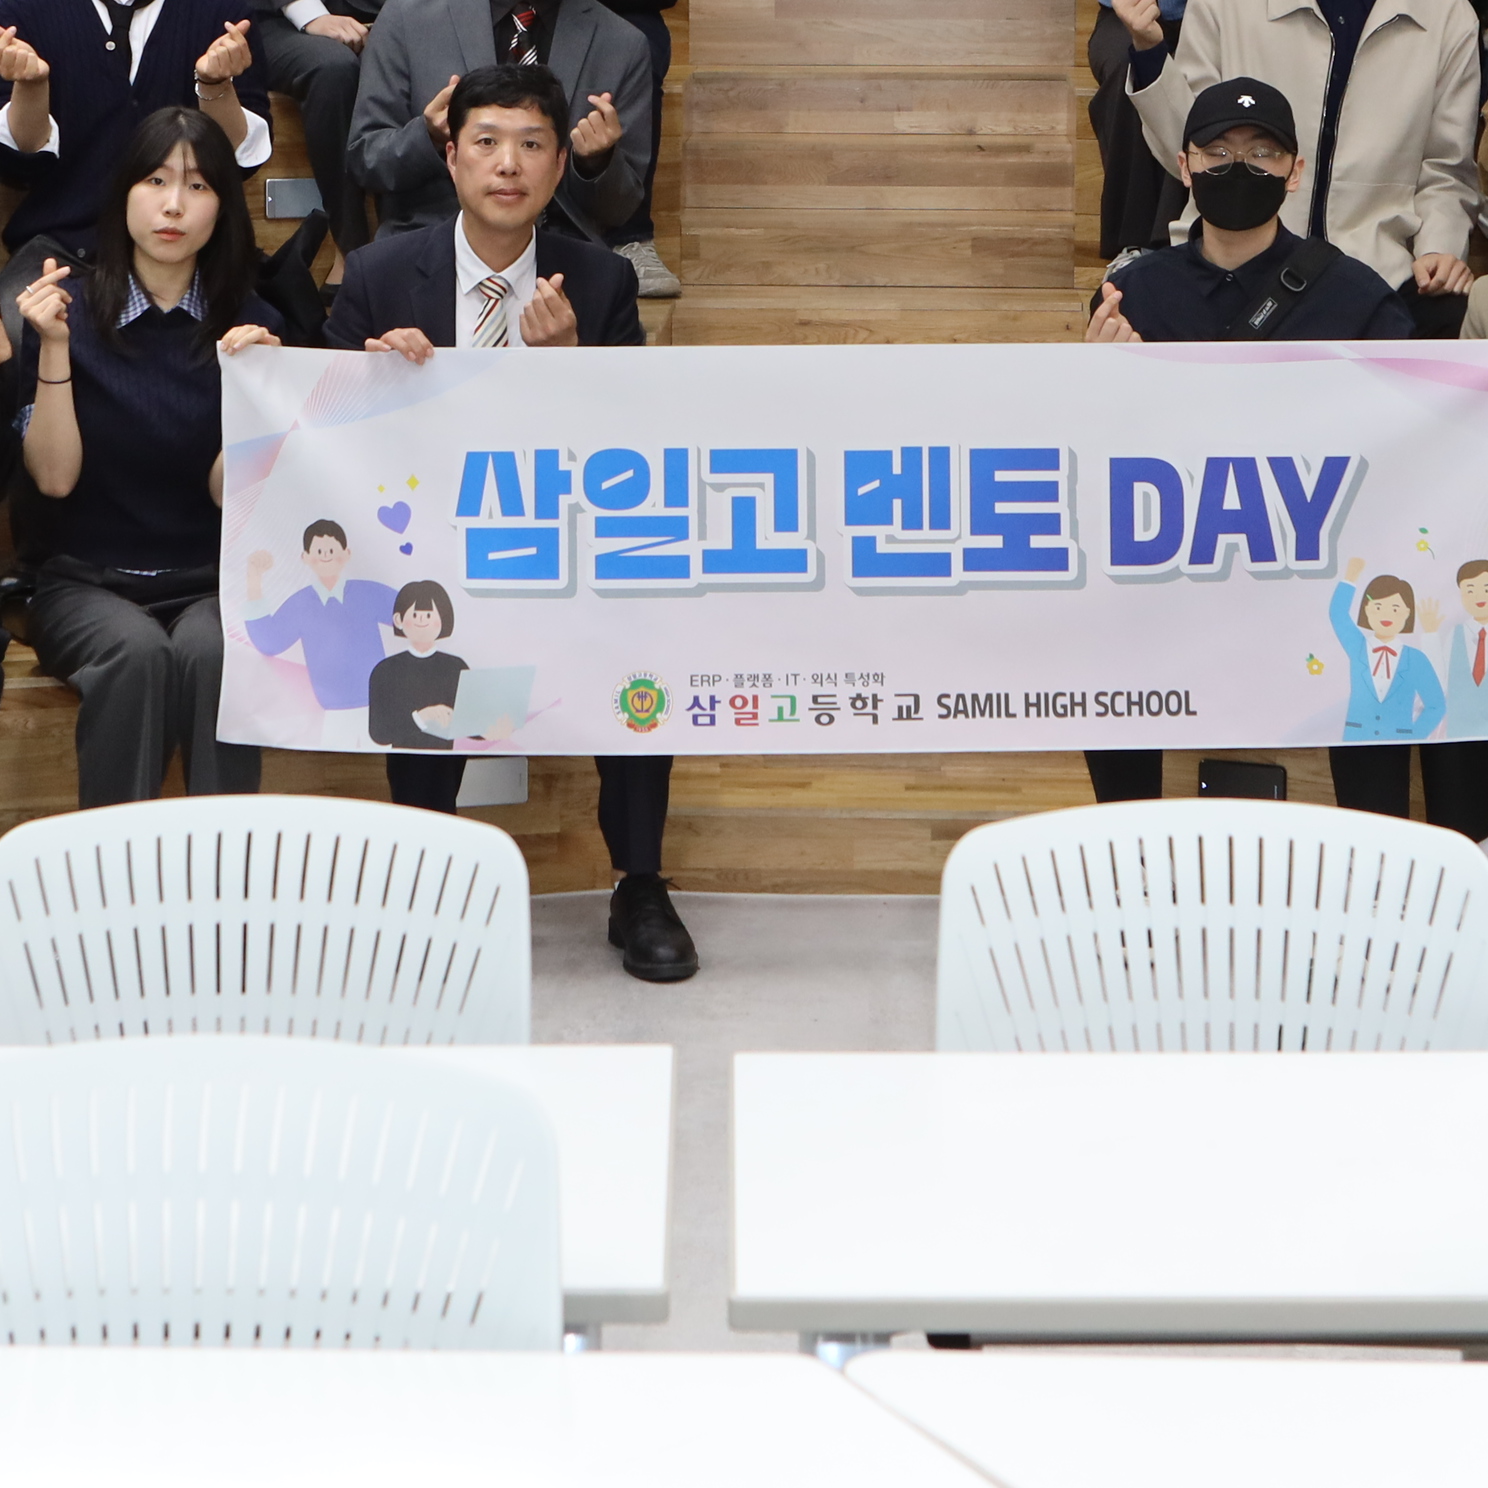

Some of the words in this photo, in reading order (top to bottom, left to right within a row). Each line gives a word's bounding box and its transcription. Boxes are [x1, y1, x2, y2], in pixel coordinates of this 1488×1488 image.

[454, 446, 808, 580] 삼일고
[843, 445, 1070, 578] 멘토
[1109, 455, 1352, 567] DAY
[843, 671, 886, 687] 특성화
[685, 693, 924, 726] 삼일고등학교
[936, 692, 1017, 719] SAMIL
[1023, 691, 1087, 718] HIGH
[1093, 690, 1198, 717] SCHOOL
